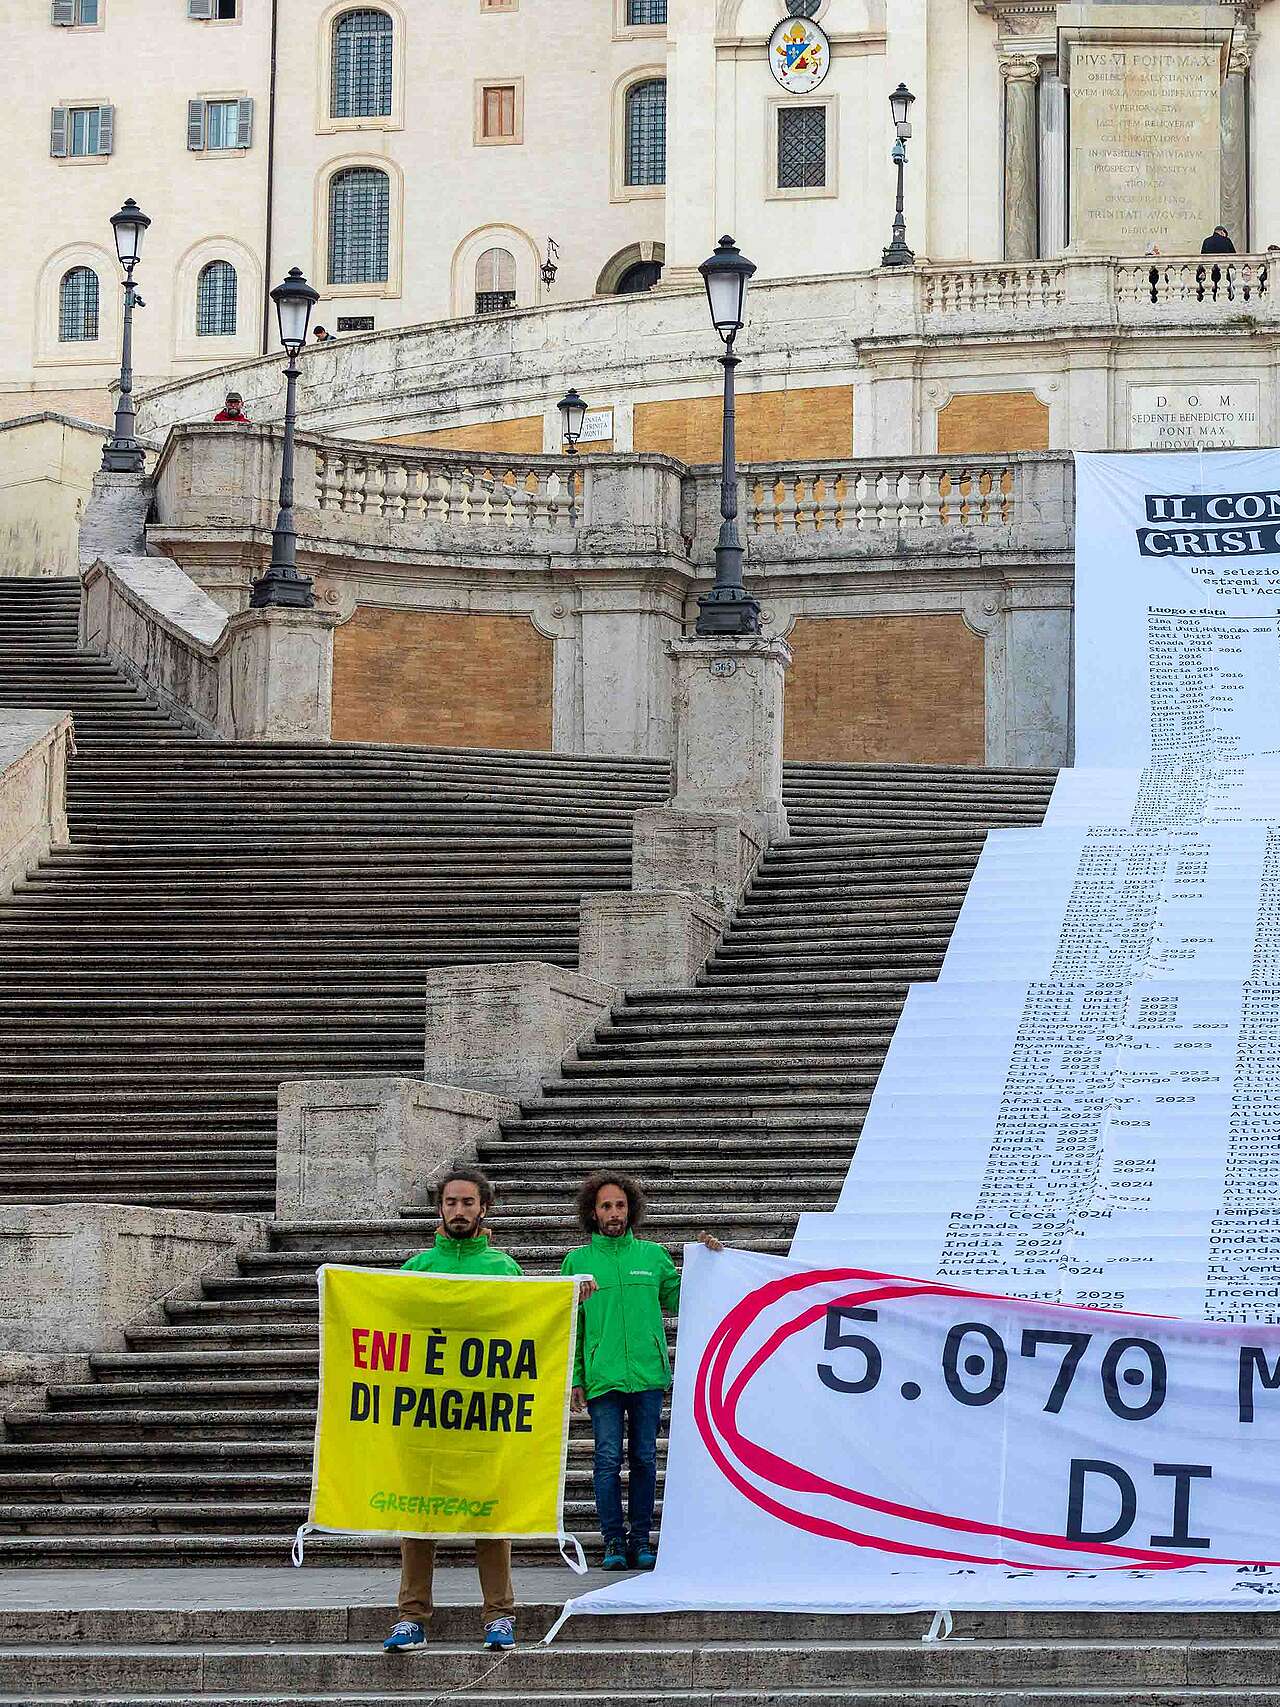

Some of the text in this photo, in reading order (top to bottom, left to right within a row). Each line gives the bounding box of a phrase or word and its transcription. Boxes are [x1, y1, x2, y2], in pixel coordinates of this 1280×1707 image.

[1076, 55, 1106, 66] PIVS
[1132, 413, 1255, 423] SEDENTE BENEDICTO XIII
[1152, 498, 1196, 519] IL
[1144, 530, 1265, 554] CRISI
[1191, 567, 1215, 576] Una
[1204, 578, 1259, 586] estremi
[1001, 1097, 1063, 1105] Africa
[996, 1121, 1101, 1129] Madagascar
[950, 1212, 993, 1221] Rep.
[1009, 1212, 1057, 1220] Ceca
[948, 1222, 1018, 1230] Canada
[944, 1240, 1004, 1248] India
[1209, 1235, 1280, 1244] Ondata
[942, 1250, 1000, 1258] Nepal
[936, 1267, 1047, 1276] Australia
[1207, 1265, 1227, 1273] Il
[352, 1328, 538, 1380] ENI È ORA
[816, 1305, 1168, 1422] 5.070
[350, 1382, 535, 1433] DI PAGARE
[368, 1491, 499, 1518] GREENPEACE
[1065, 1457, 1212, 1549] DI
